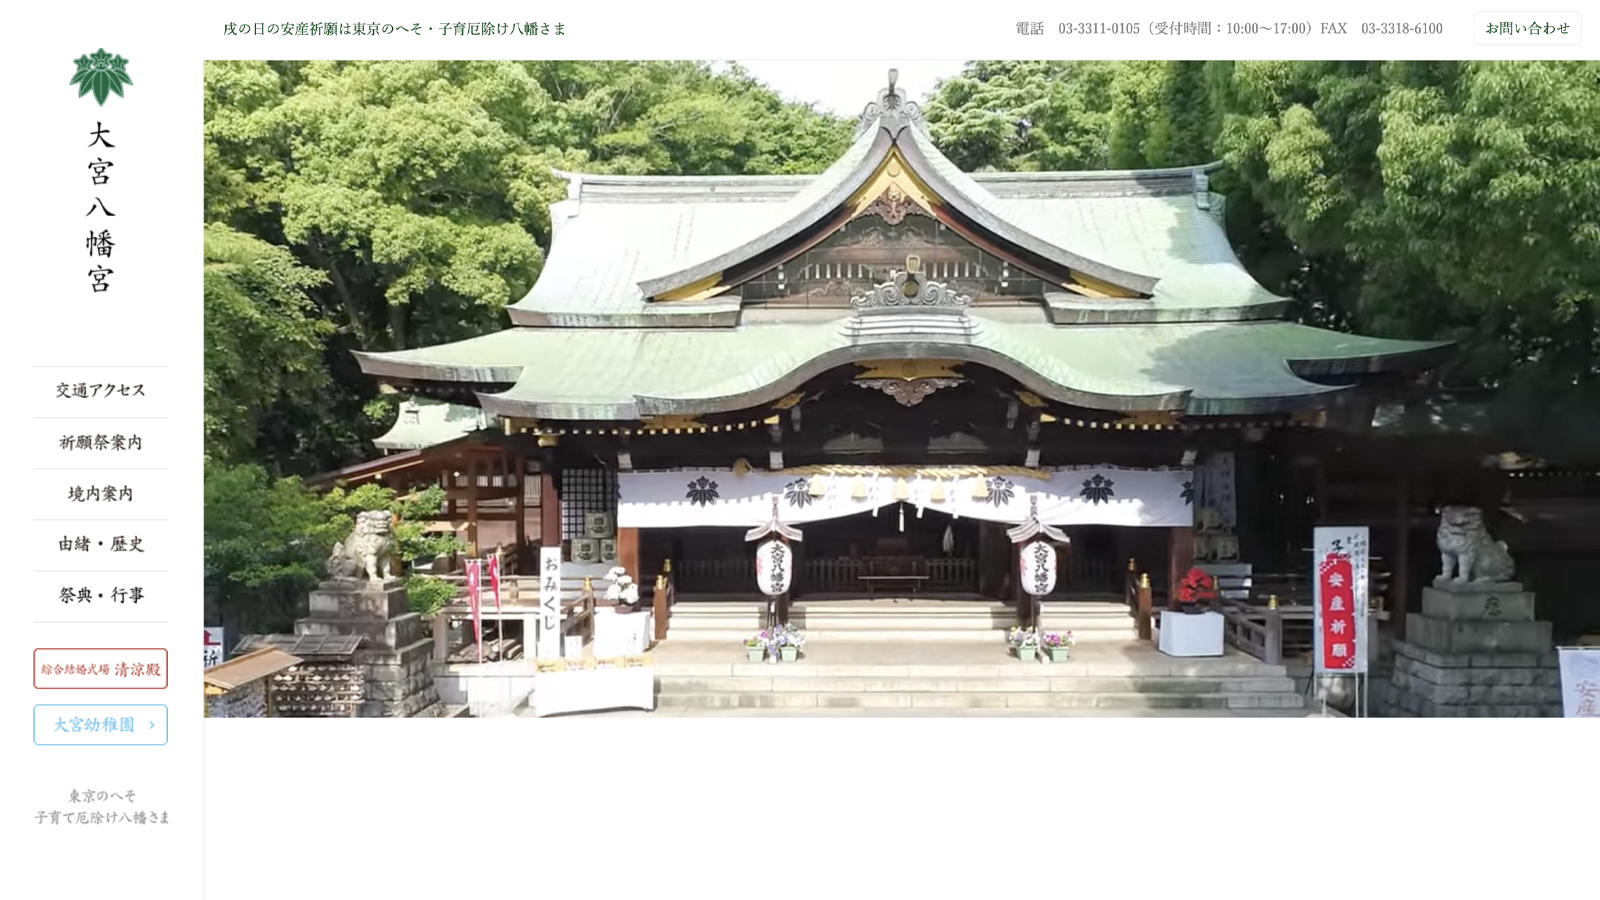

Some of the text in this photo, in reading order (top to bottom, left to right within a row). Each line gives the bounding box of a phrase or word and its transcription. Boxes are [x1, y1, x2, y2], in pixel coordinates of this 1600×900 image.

[543, 556, 559, 631] おみくじ
[770, 543, 786, 593] 大宮八幡宮
[1033, 543, 1050, 594] 大宮八幡宮
[1327, 571, 1348, 658] 安産祈願
